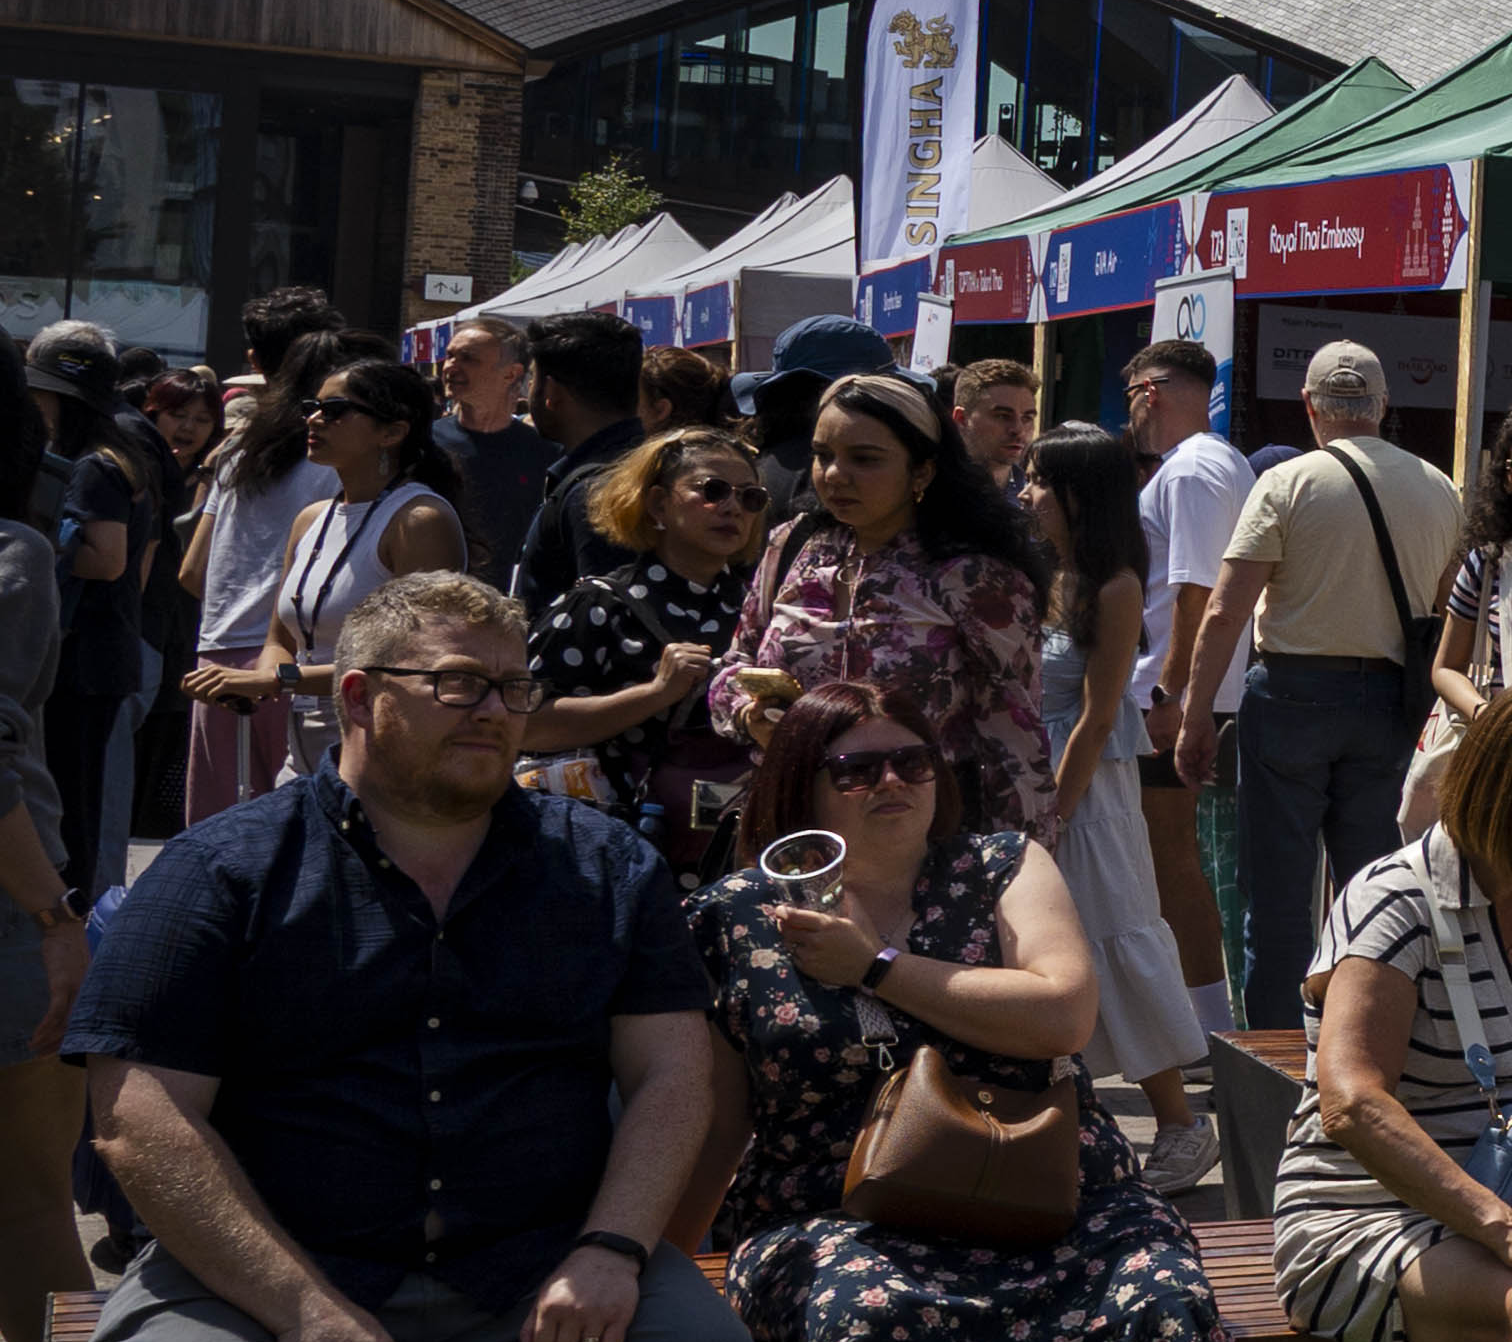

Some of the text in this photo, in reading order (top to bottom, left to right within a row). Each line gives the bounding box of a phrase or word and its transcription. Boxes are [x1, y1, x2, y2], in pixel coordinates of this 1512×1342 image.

[906, 76, 943, 247] SINGHA
[1269, 221, 1298, 264] Royal
[1299, 221, 1321, 252] Thai
[1321, 216, 1365, 259] Embassy
